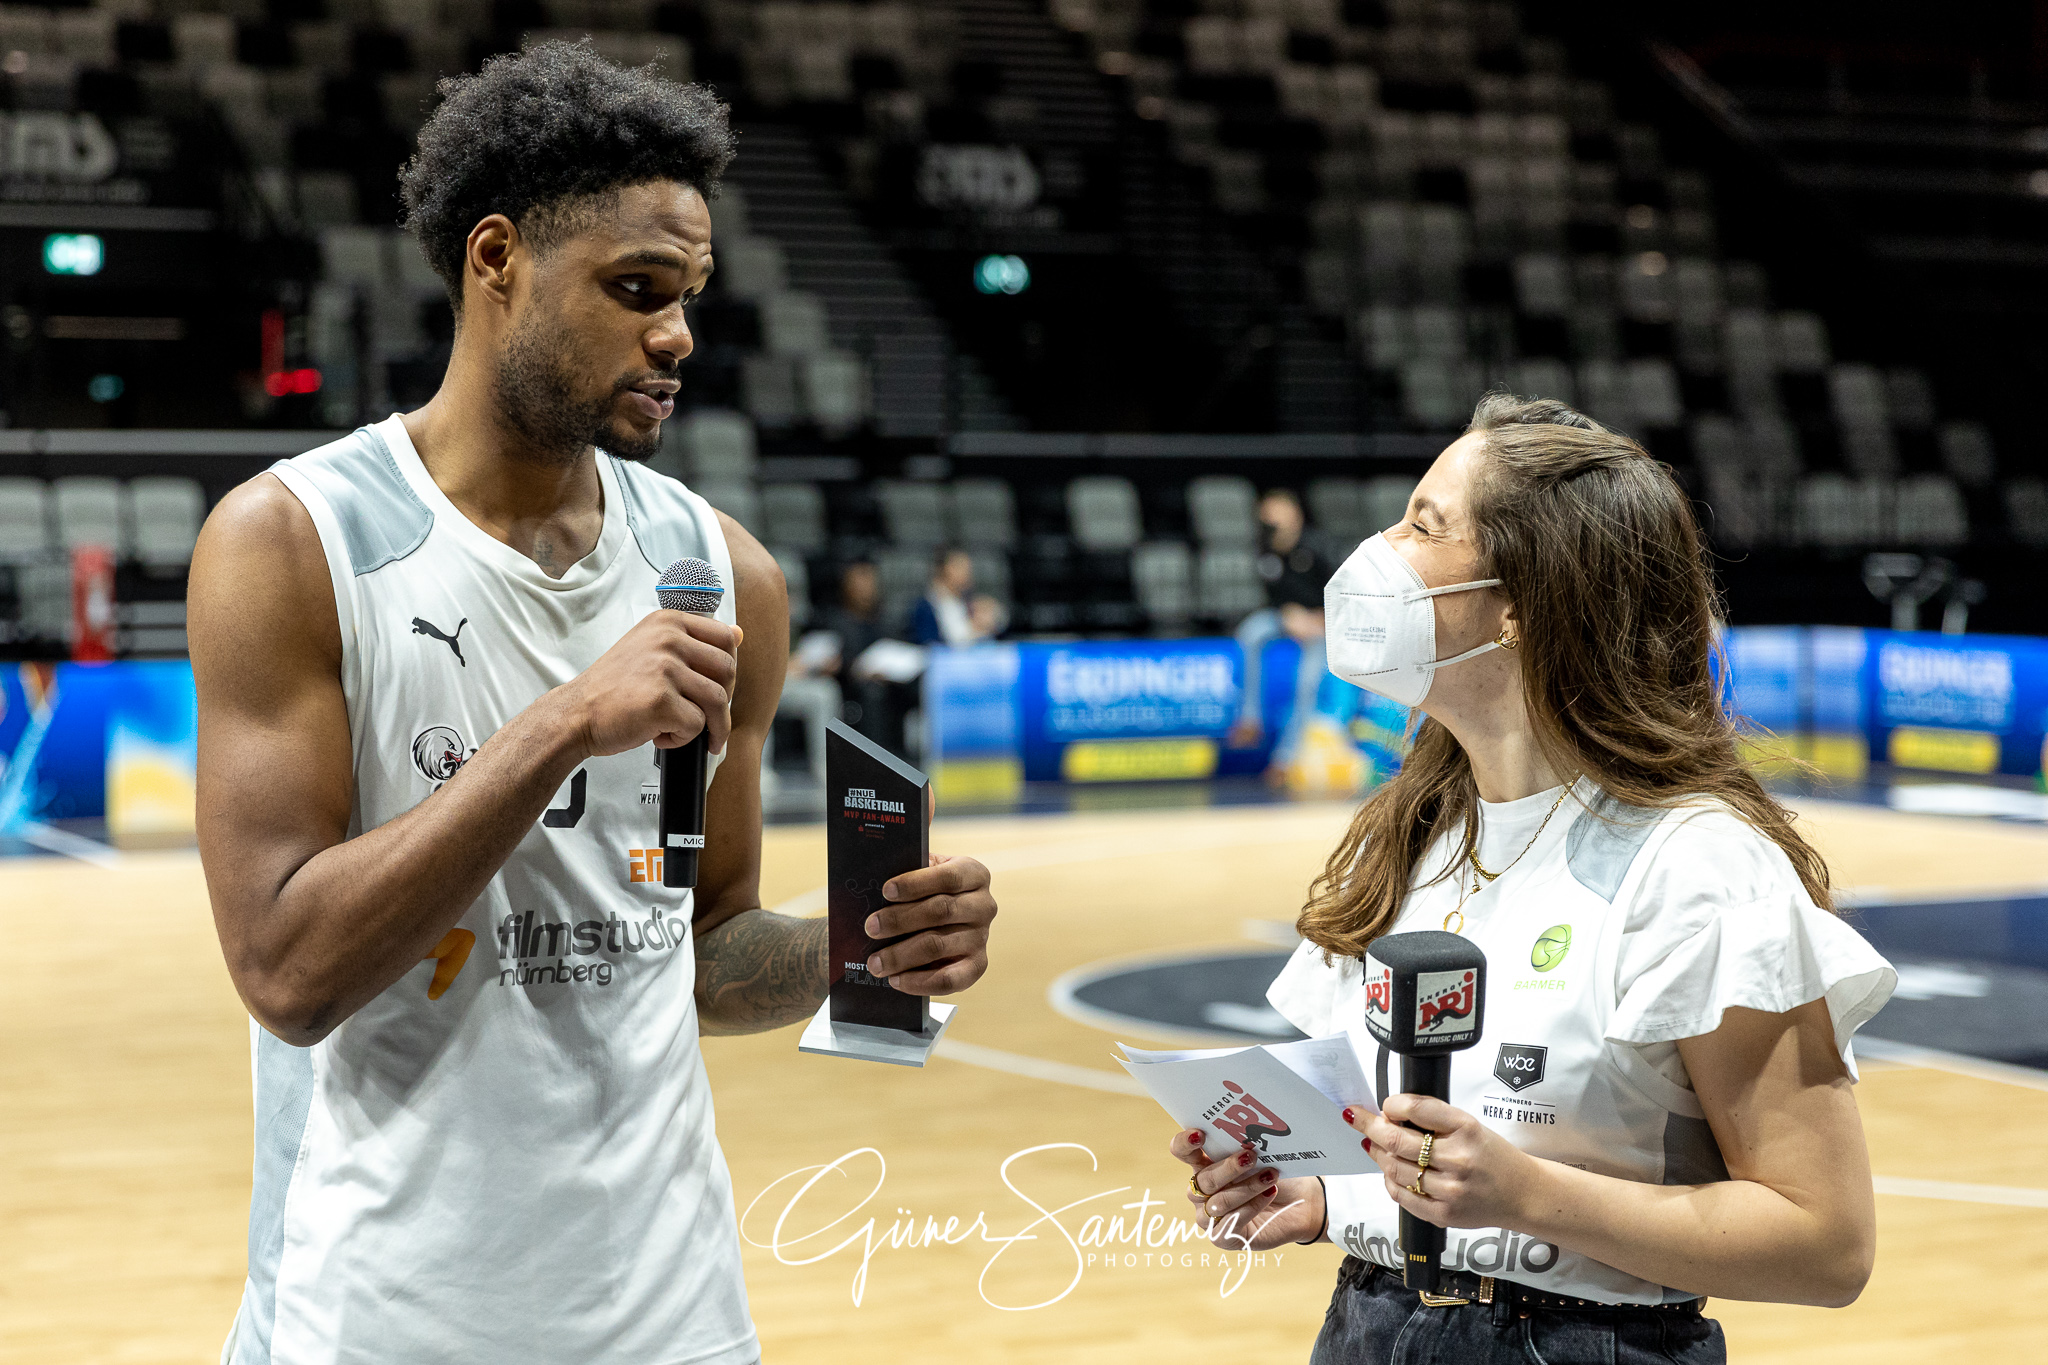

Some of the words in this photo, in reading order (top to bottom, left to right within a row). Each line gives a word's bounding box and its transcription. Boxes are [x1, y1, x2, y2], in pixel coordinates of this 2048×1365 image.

[849, 789, 874, 797] #NUE
[844, 796, 906, 813] BASKETBALL
[844, 810, 859, 819] MVP
[863, 812, 906, 824] FAN-AWARD
[498, 906, 686, 959] filmstudio
[499, 959, 612, 987] nürnberg
[844, 961, 864, 970] MOST
[844, 970, 892, 988] PLAYE
[1513, 979, 1566, 991] BARMER
[1419, 981, 1462, 1003] ENERGY
[1419, 971, 1474, 1032] NRJ
[1416, 1036, 1428, 1045] HIT
[1429, 1035, 1451, 1044] MUSIC
[1452, 1032, 1469, 1041] ONLY
[1503, 1054, 1536, 1072] wbe
[1201, 1091, 1235, 1121] ENERGY
[1482, 1104, 1513, 1120] WERK:B
[1516, 1109, 1556, 1125] EVENTS
[1211, 1079, 1292, 1152] NRJ
[1257, 1154, 1274, 1164] HIT
[1271, 1151, 1300, 1163] MUSIC
[1298, 1150, 1321, 1160] ONLY
[1343, 1222, 1559, 1274] filmsudio
